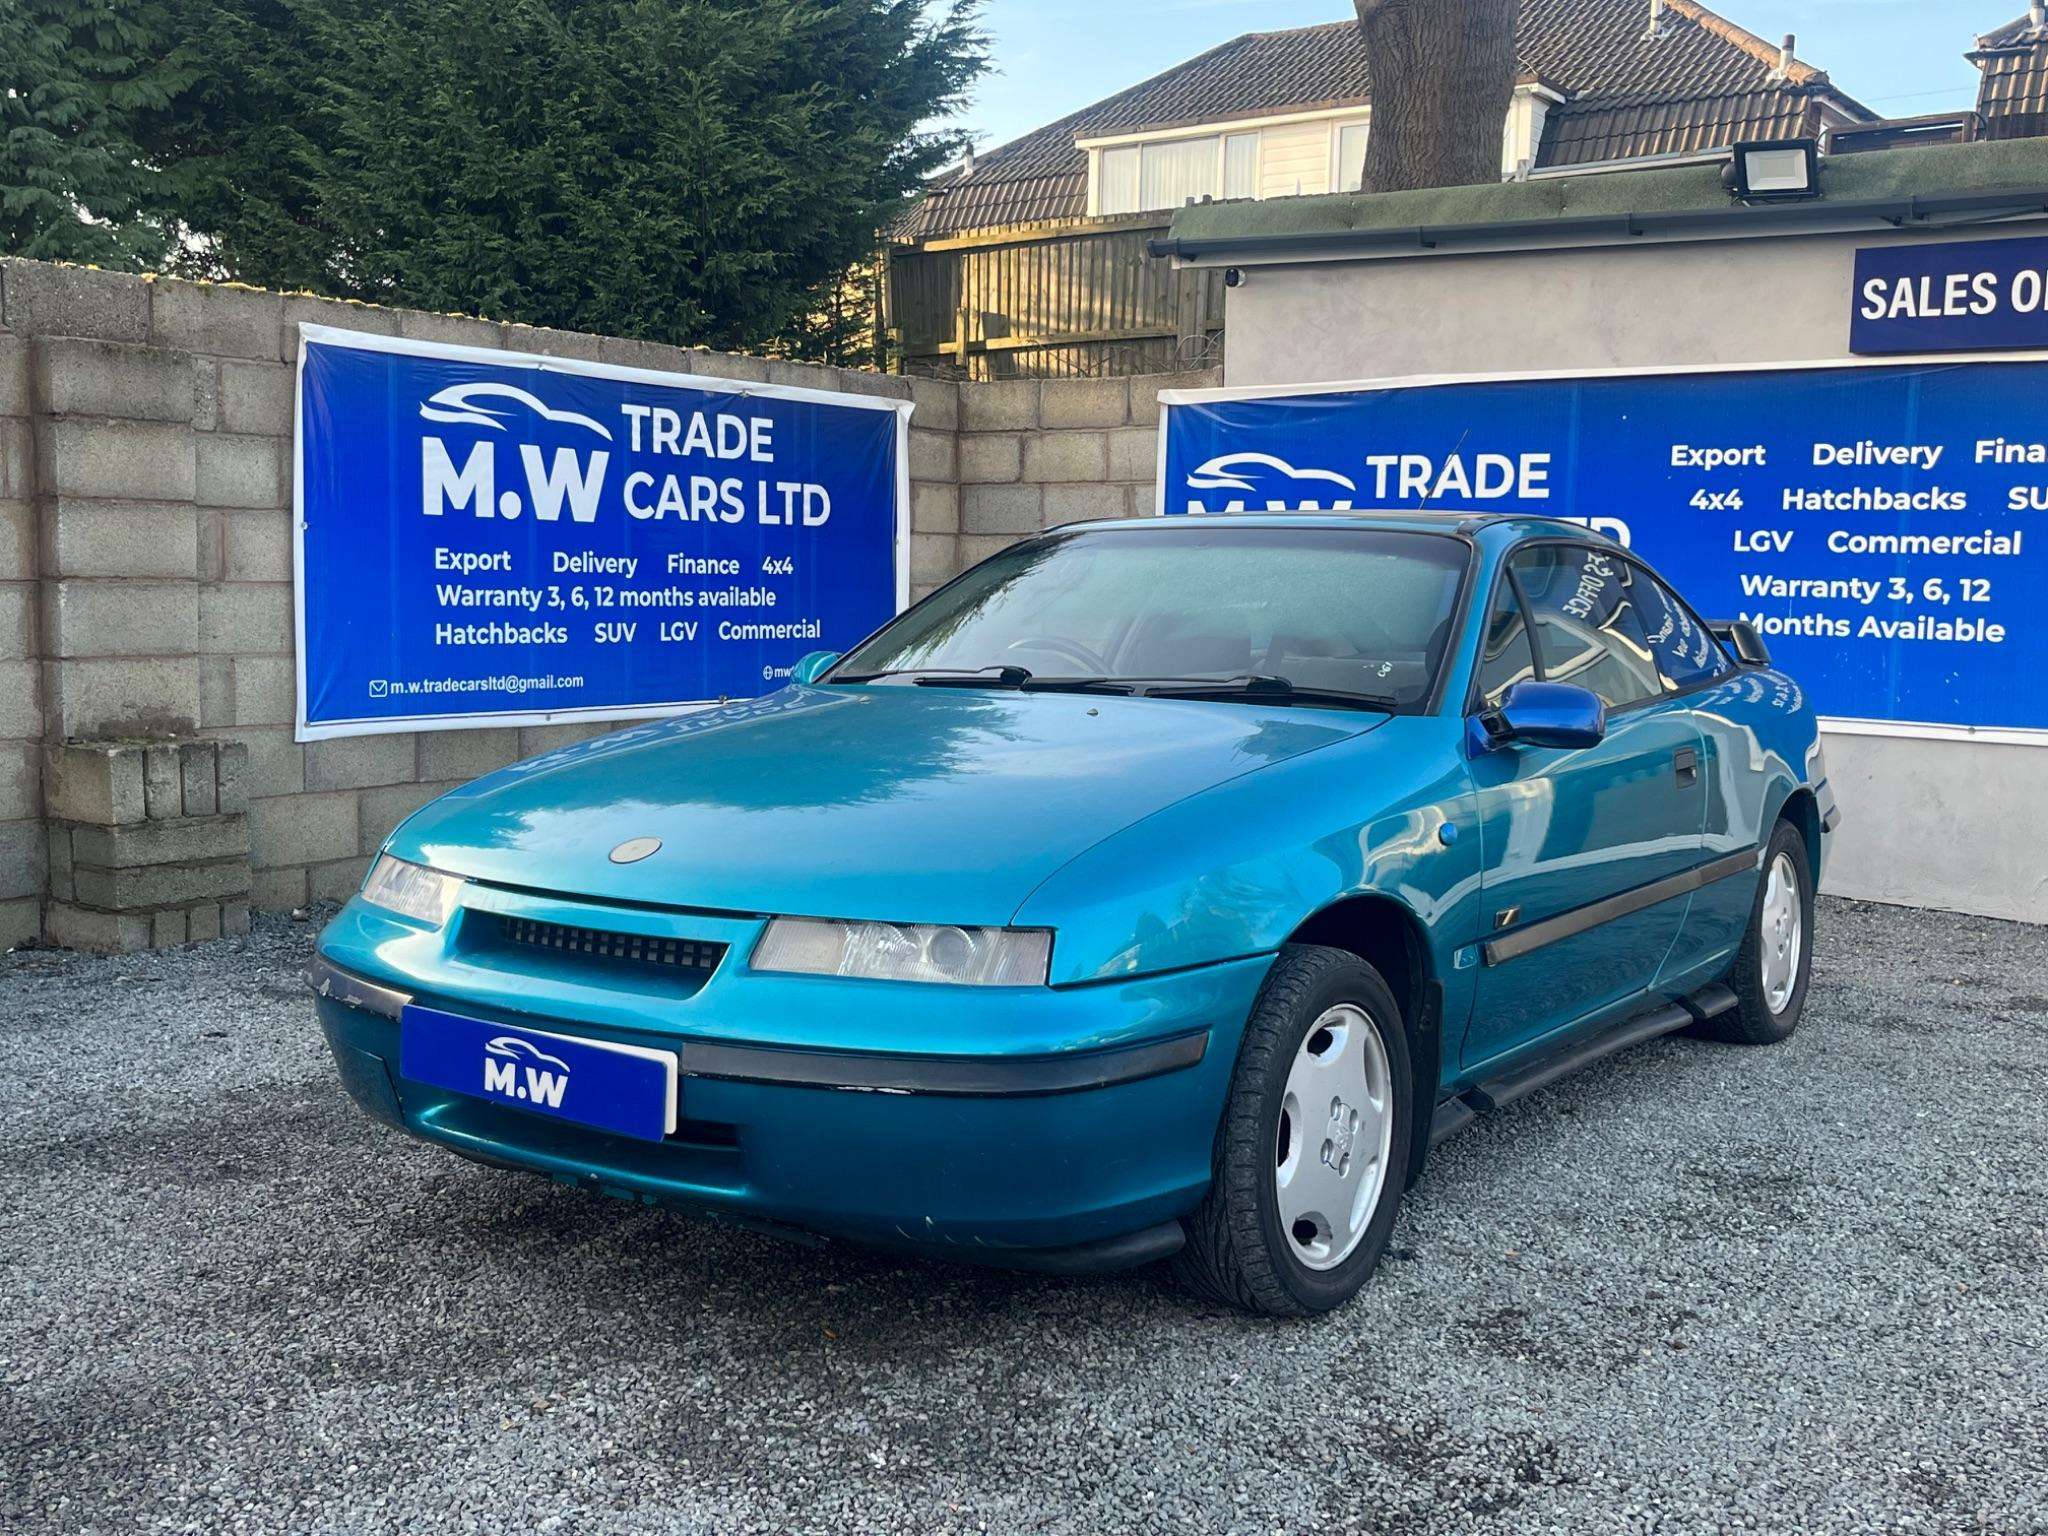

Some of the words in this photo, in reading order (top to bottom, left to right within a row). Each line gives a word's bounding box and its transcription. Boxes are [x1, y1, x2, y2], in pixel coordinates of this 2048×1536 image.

[1861, 272, 1997, 319] SALES
[2011, 269, 2048, 313] O
[621, 404, 773, 462] TRADE
[1671, 445, 1765, 470] Export
[1813, 441, 1943, 469] Delivery
[423, 437, 610, 522] M.W
[1366, 453, 1551, 499] TRADE
[624, 472, 744, 523] CARS
[759, 481, 830, 526] LTD
[1690, 489, 1743, 510] 4x4
[1783, 487, 1966, 510] Hatchbacks
[1734, 531, 1793, 552] LGV
[1828, 530, 2021, 554] Commercial
[436, 548, 511, 575] Export
[554, 551, 637, 578] Delivery
[668, 553, 739, 574] Finance
[762, 556, 793, 574] 4x4
[436, 585, 542, 611] Warranty
[548, 586, 565, 610] 3,
[571, 586, 589, 609] 6,
[594, 587, 614, 606] 12
[620, 586, 693, 606] months
[699, 586, 776, 606] available
[1741, 575, 1881, 604] Warranty
[1888, 578, 1913, 604] 3,
[1923, 578, 1950, 604] 6,
[1960, 579, 1990, 601] 12
[436, 622, 567, 644] Hatchbacks
[595, 623, 636, 643] SUV
[661, 622, 698, 641] LGV
[719, 619, 820, 640] Commercial
[1738, 612, 1850, 636] Months
[1858, 616, 2005, 642] Available
[391, 675, 583, 693] m.w.tradecarsltd@gmail.com
[485, 1057, 568, 1108] M.W
